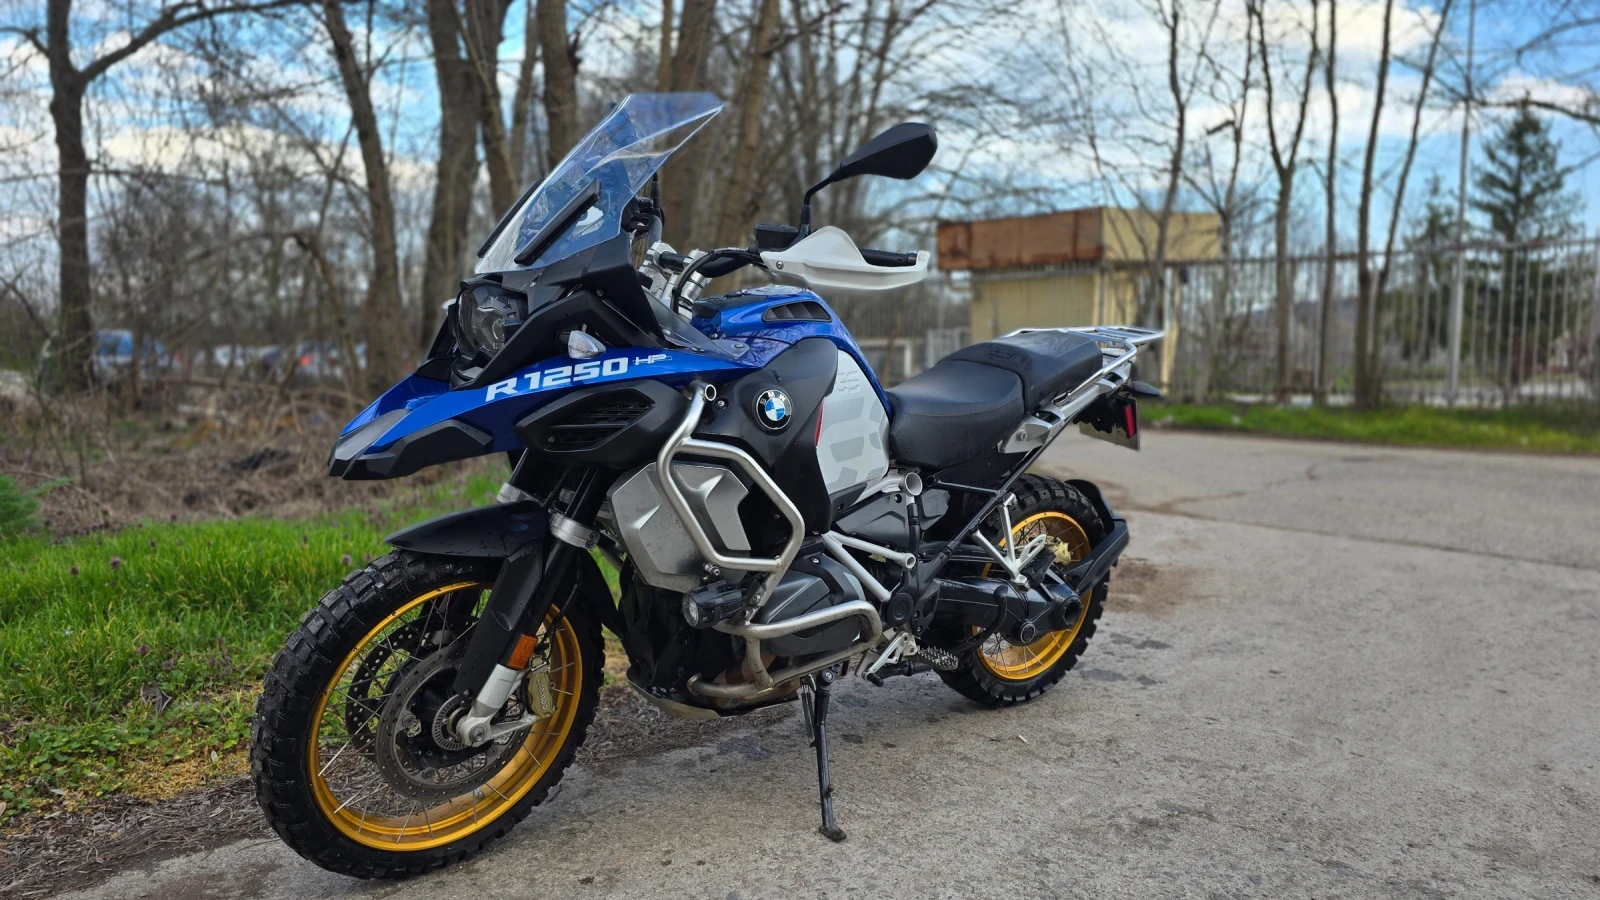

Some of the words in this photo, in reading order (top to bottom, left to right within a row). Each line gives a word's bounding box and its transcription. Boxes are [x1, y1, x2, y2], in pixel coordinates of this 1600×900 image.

[633, 354, 670, 366] HP
[760, 391, 786, 404] BMW
[537, 678, 548, 710] brembo
